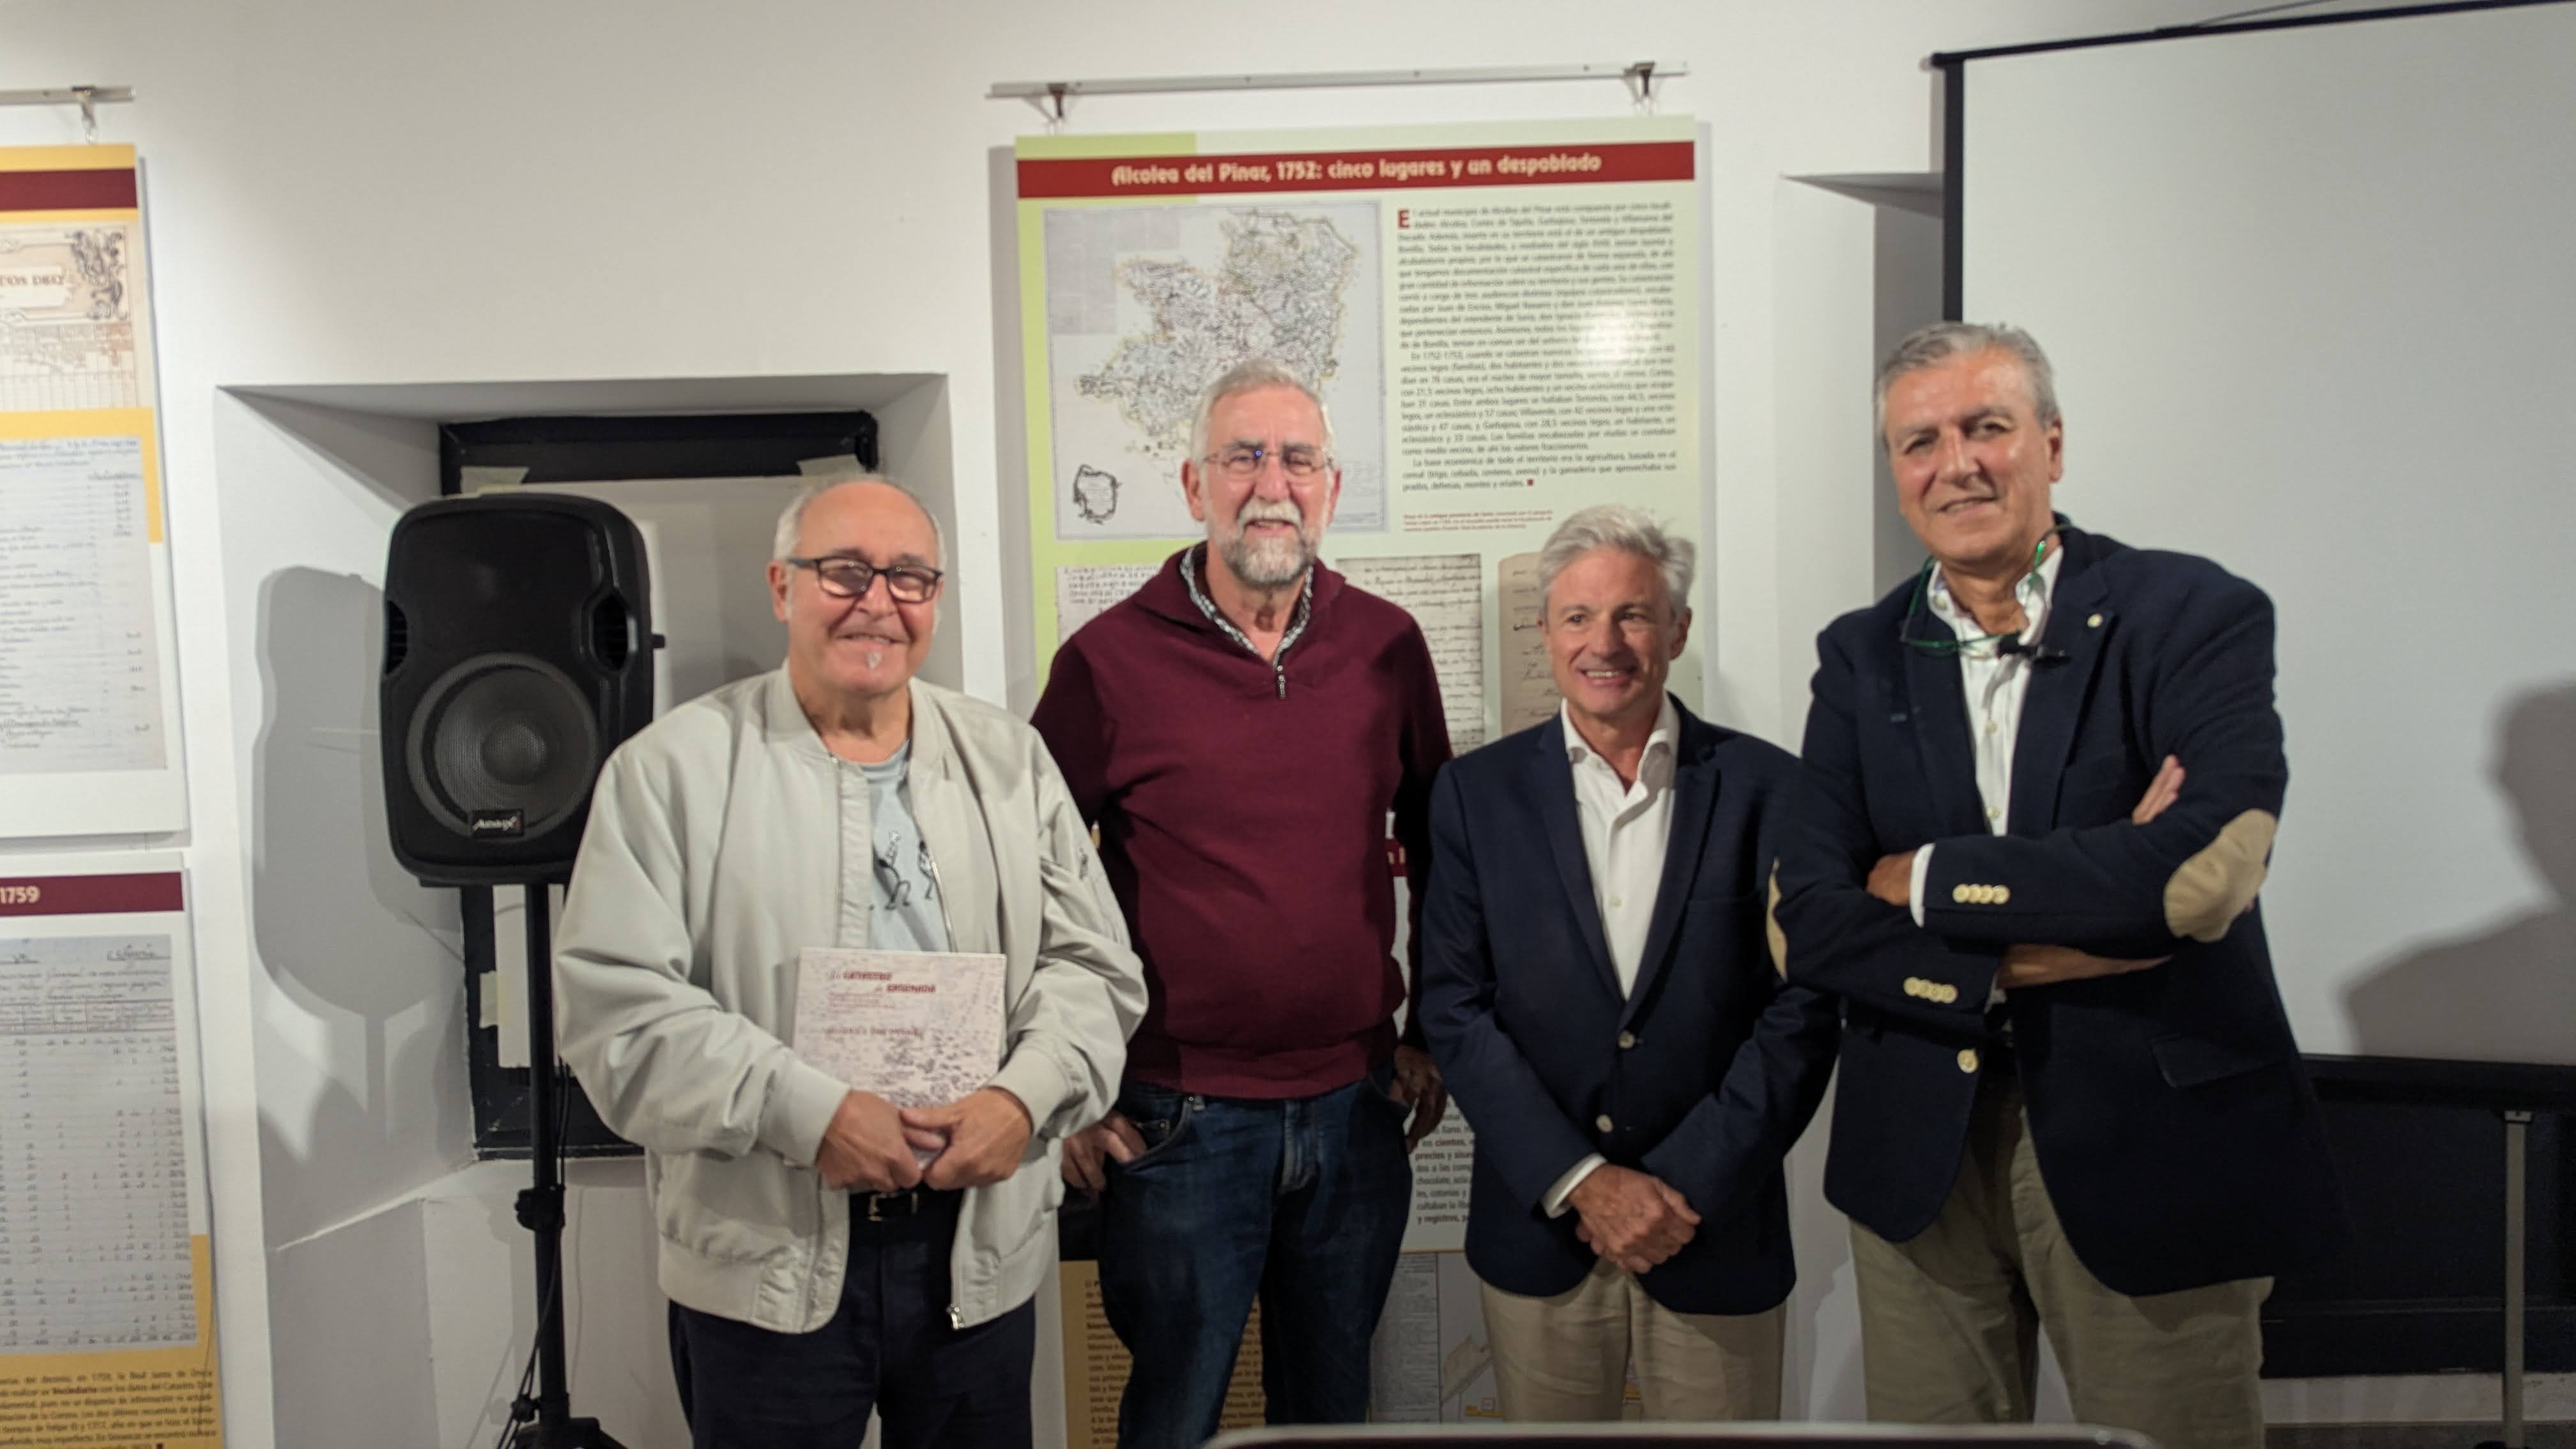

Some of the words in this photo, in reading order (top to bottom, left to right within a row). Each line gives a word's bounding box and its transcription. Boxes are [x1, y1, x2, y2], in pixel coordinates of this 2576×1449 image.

[1112, 164, 1179, 185] Alcolea
[1184, 164, 1213, 183] del
[1219, 162, 1272, 183] Pinar,
[1276, 160, 1323, 181] 1752:
[1327, 159, 1375, 179] cinco
[1379, 158, 1446, 181] lugares
[1450, 159, 1464, 180] y
[1496, 153, 1602, 177] despoblado
[0, 885, 40, 903] 1759
